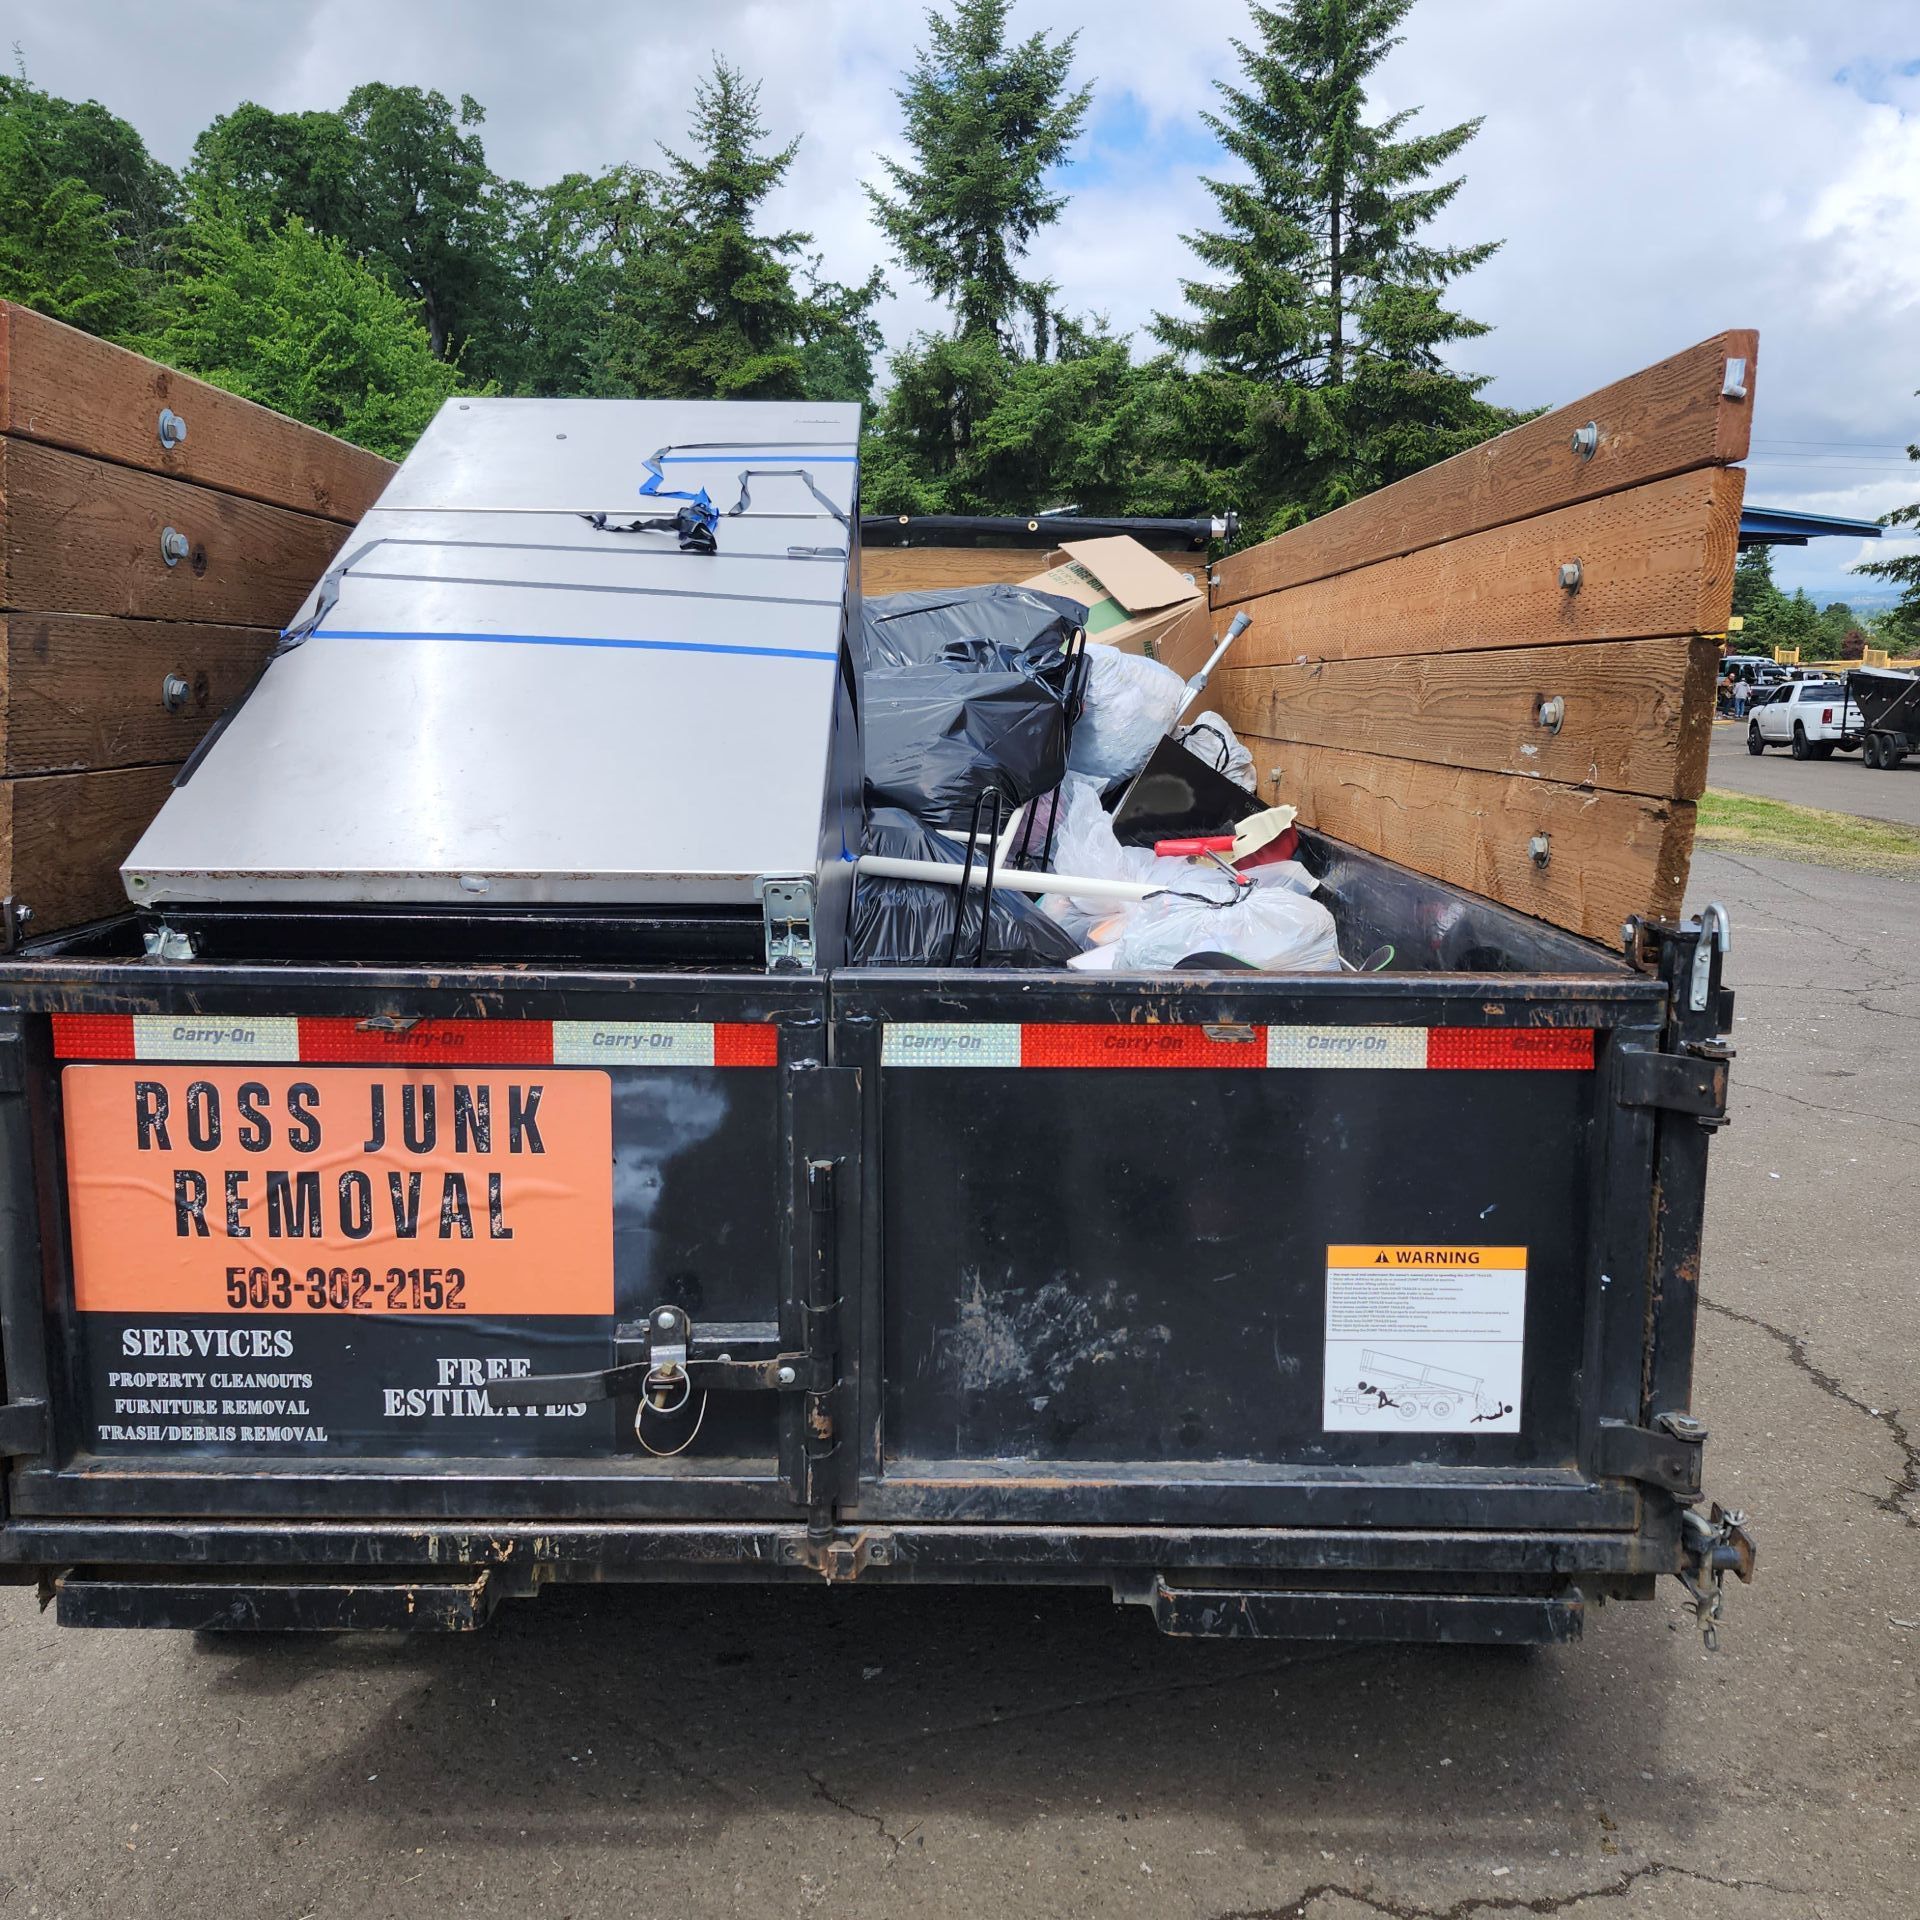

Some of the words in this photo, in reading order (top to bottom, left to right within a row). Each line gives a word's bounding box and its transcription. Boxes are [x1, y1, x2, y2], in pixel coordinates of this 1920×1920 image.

[1065, 561, 1093, 580] LARGE
[172, 1027, 255, 1045] Carry-On
[383, 1031, 464, 1048] Carry-On
[592, 1032, 673, 1050] Carry-On
[902, 1034, 982, 1051] Carry-On
[1104, 1034, 1184, 1051] Carry-On
[1306, 1035, 1387, 1052] Carry-On
[134, 1080, 322, 1152] ROSS
[363, 1083, 546, 1154] JUNK
[173, 1169, 514, 1239] REMOVAL
[1395, 1250, 1480, 1264] WARNING
[225, 1266, 466, 1310] 503-302-2152
[122, 1328, 294, 1358] SERVICES
[108, 1372, 206, 1388] PROPERTY
[209, 1373, 313, 1389] CLEANOUTS
[436, 1358, 532, 1386] FREE
[114, 1398, 218, 1415] FURNITURE
[221, 1399, 310, 1415] REMOVAL
[382, 1388, 588, 1417] ESTIM
[98, 1425, 237, 1441] TRASH/DEBRIS
[240, 1426, 328, 1442] REMOVAL
